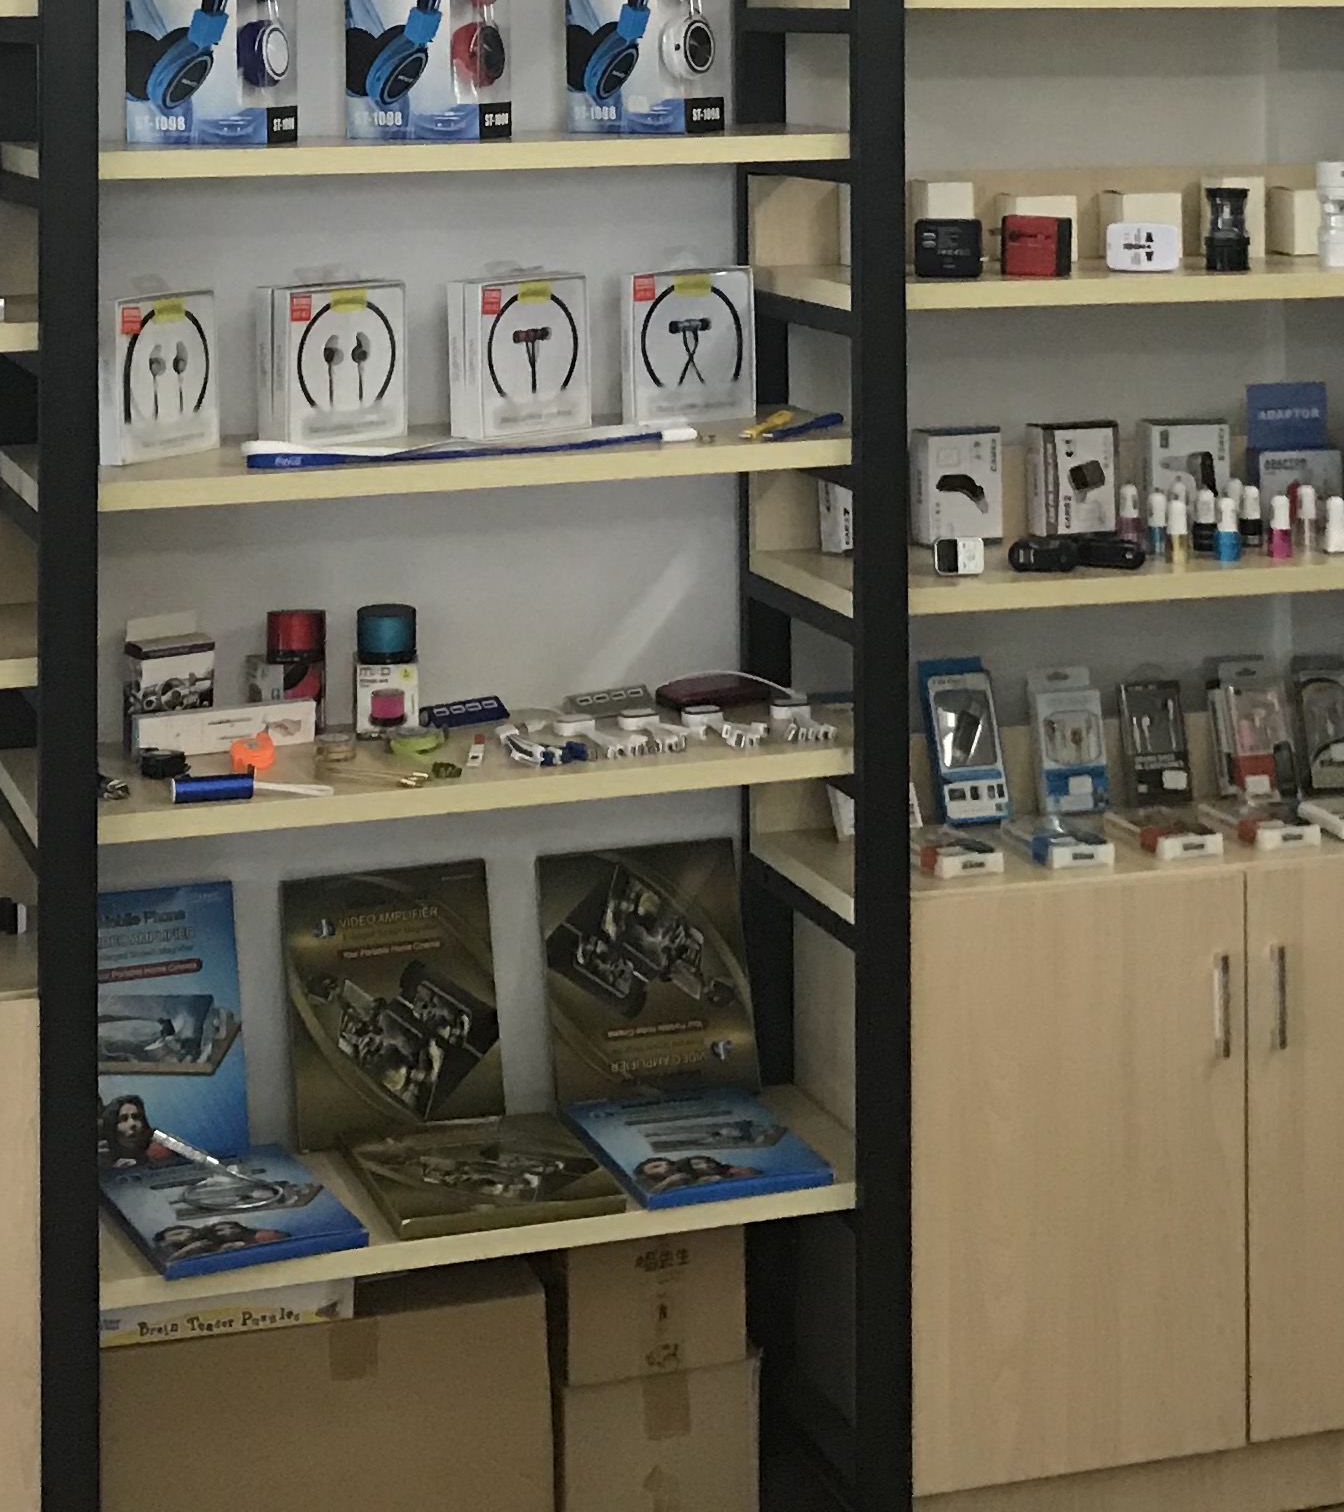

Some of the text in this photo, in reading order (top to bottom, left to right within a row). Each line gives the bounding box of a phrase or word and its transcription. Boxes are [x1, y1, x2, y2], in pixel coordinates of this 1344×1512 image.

[1258, 407, 1320, 421] ADAPTOR
[143, 908, 186, 924] Phone
[339, 906, 439, 929] VIDEO AMPLIFIER
[137, 1321, 180, 1337] Brain
